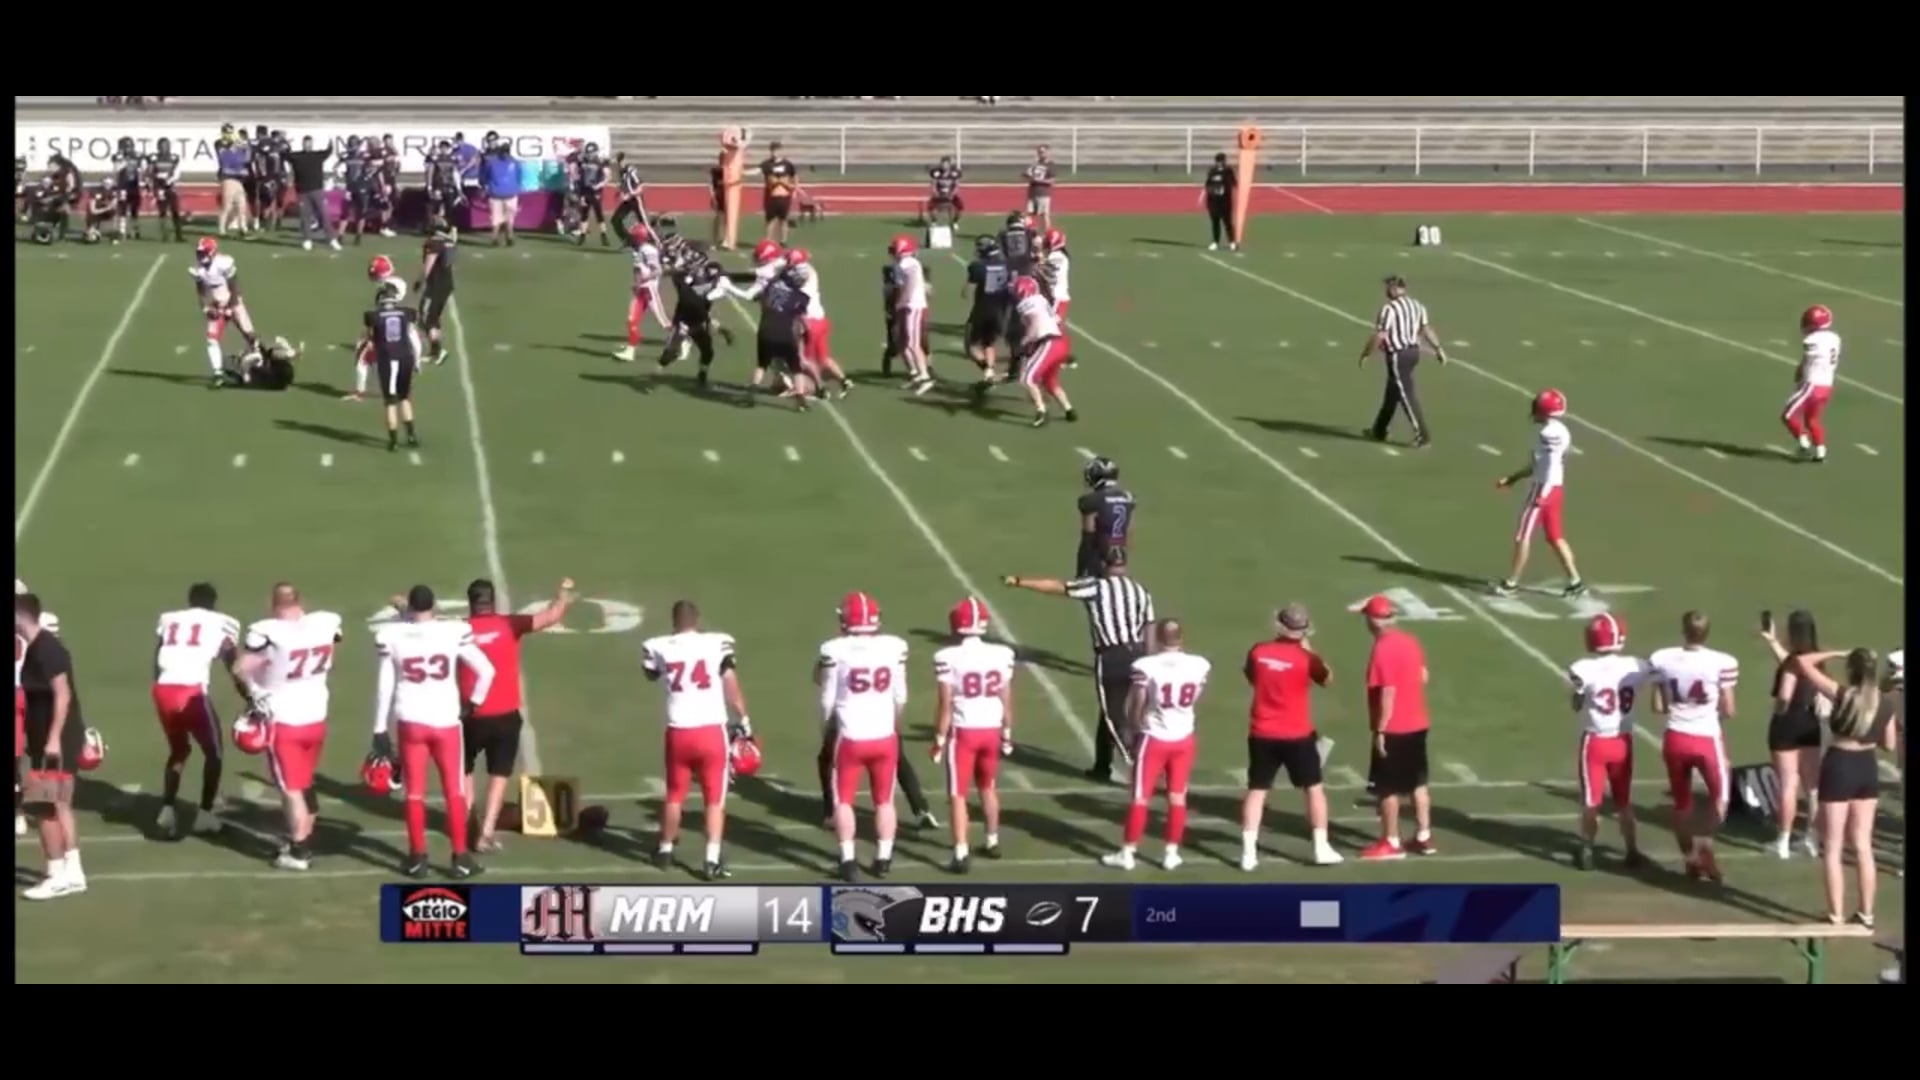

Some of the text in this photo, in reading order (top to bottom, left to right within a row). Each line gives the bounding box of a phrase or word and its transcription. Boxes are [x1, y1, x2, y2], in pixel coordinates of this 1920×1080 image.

[1418, 225, 1441, 245] 30
[1111, 504, 1126, 538] 2
[166, 622, 201, 646] 11
[286, 645, 333, 679] 77
[402, 654, 450, 684] 53
[665, 659, 711, 692] 74
[848, 666, 891, 694] 58
[962, 670, 1002, 699] 82
[1671, 678, 1709, 706] 14
[1160, 683, 1196, 709] 18
[526, 780, 575, 830] 50
